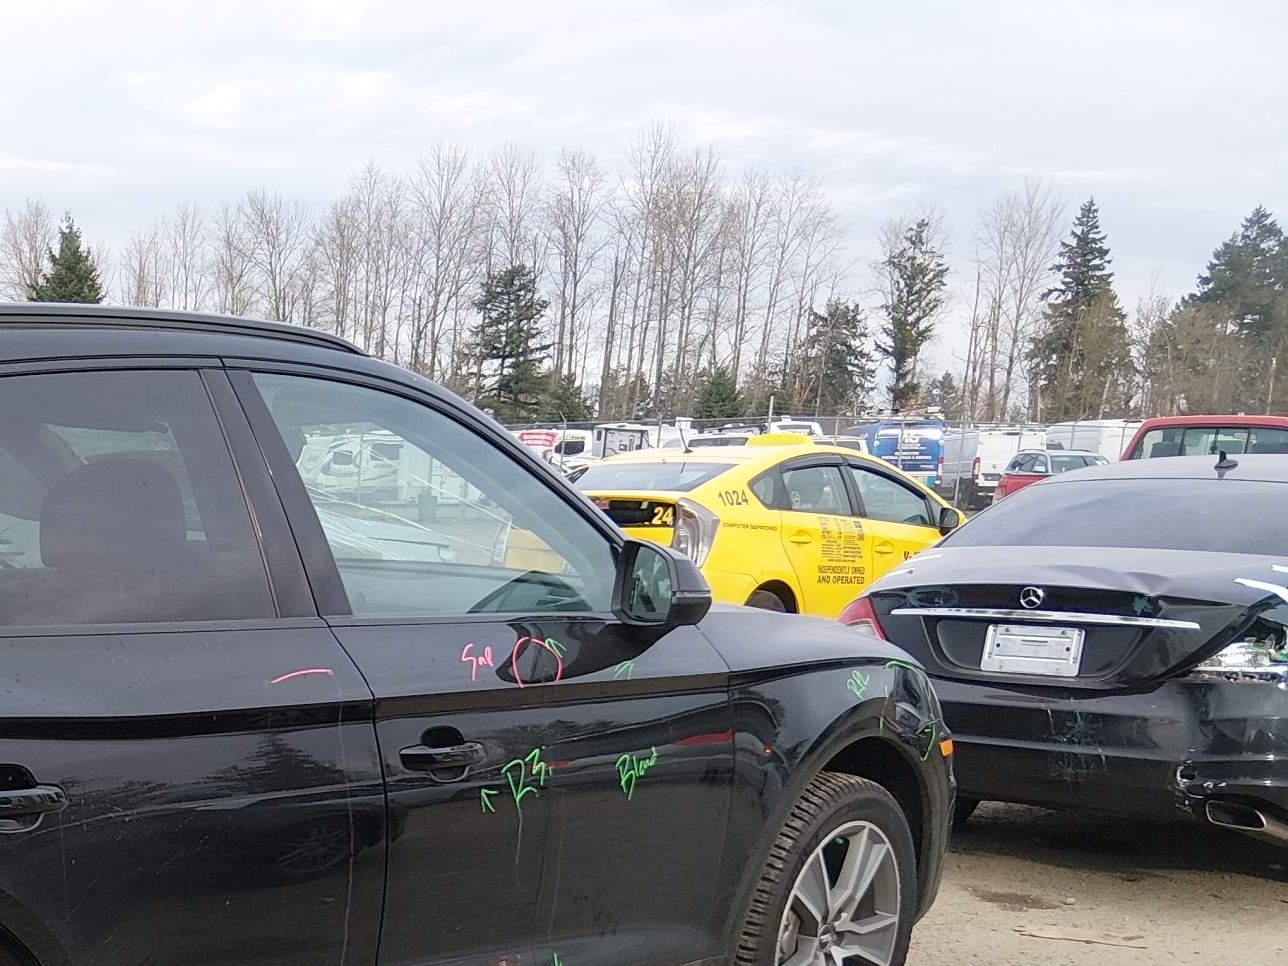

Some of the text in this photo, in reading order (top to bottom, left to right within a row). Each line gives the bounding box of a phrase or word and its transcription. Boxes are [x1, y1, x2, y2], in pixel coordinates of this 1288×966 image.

[718, 489, 749, 507] 1024
[817, 575, 865, 585] AND OPERATED
